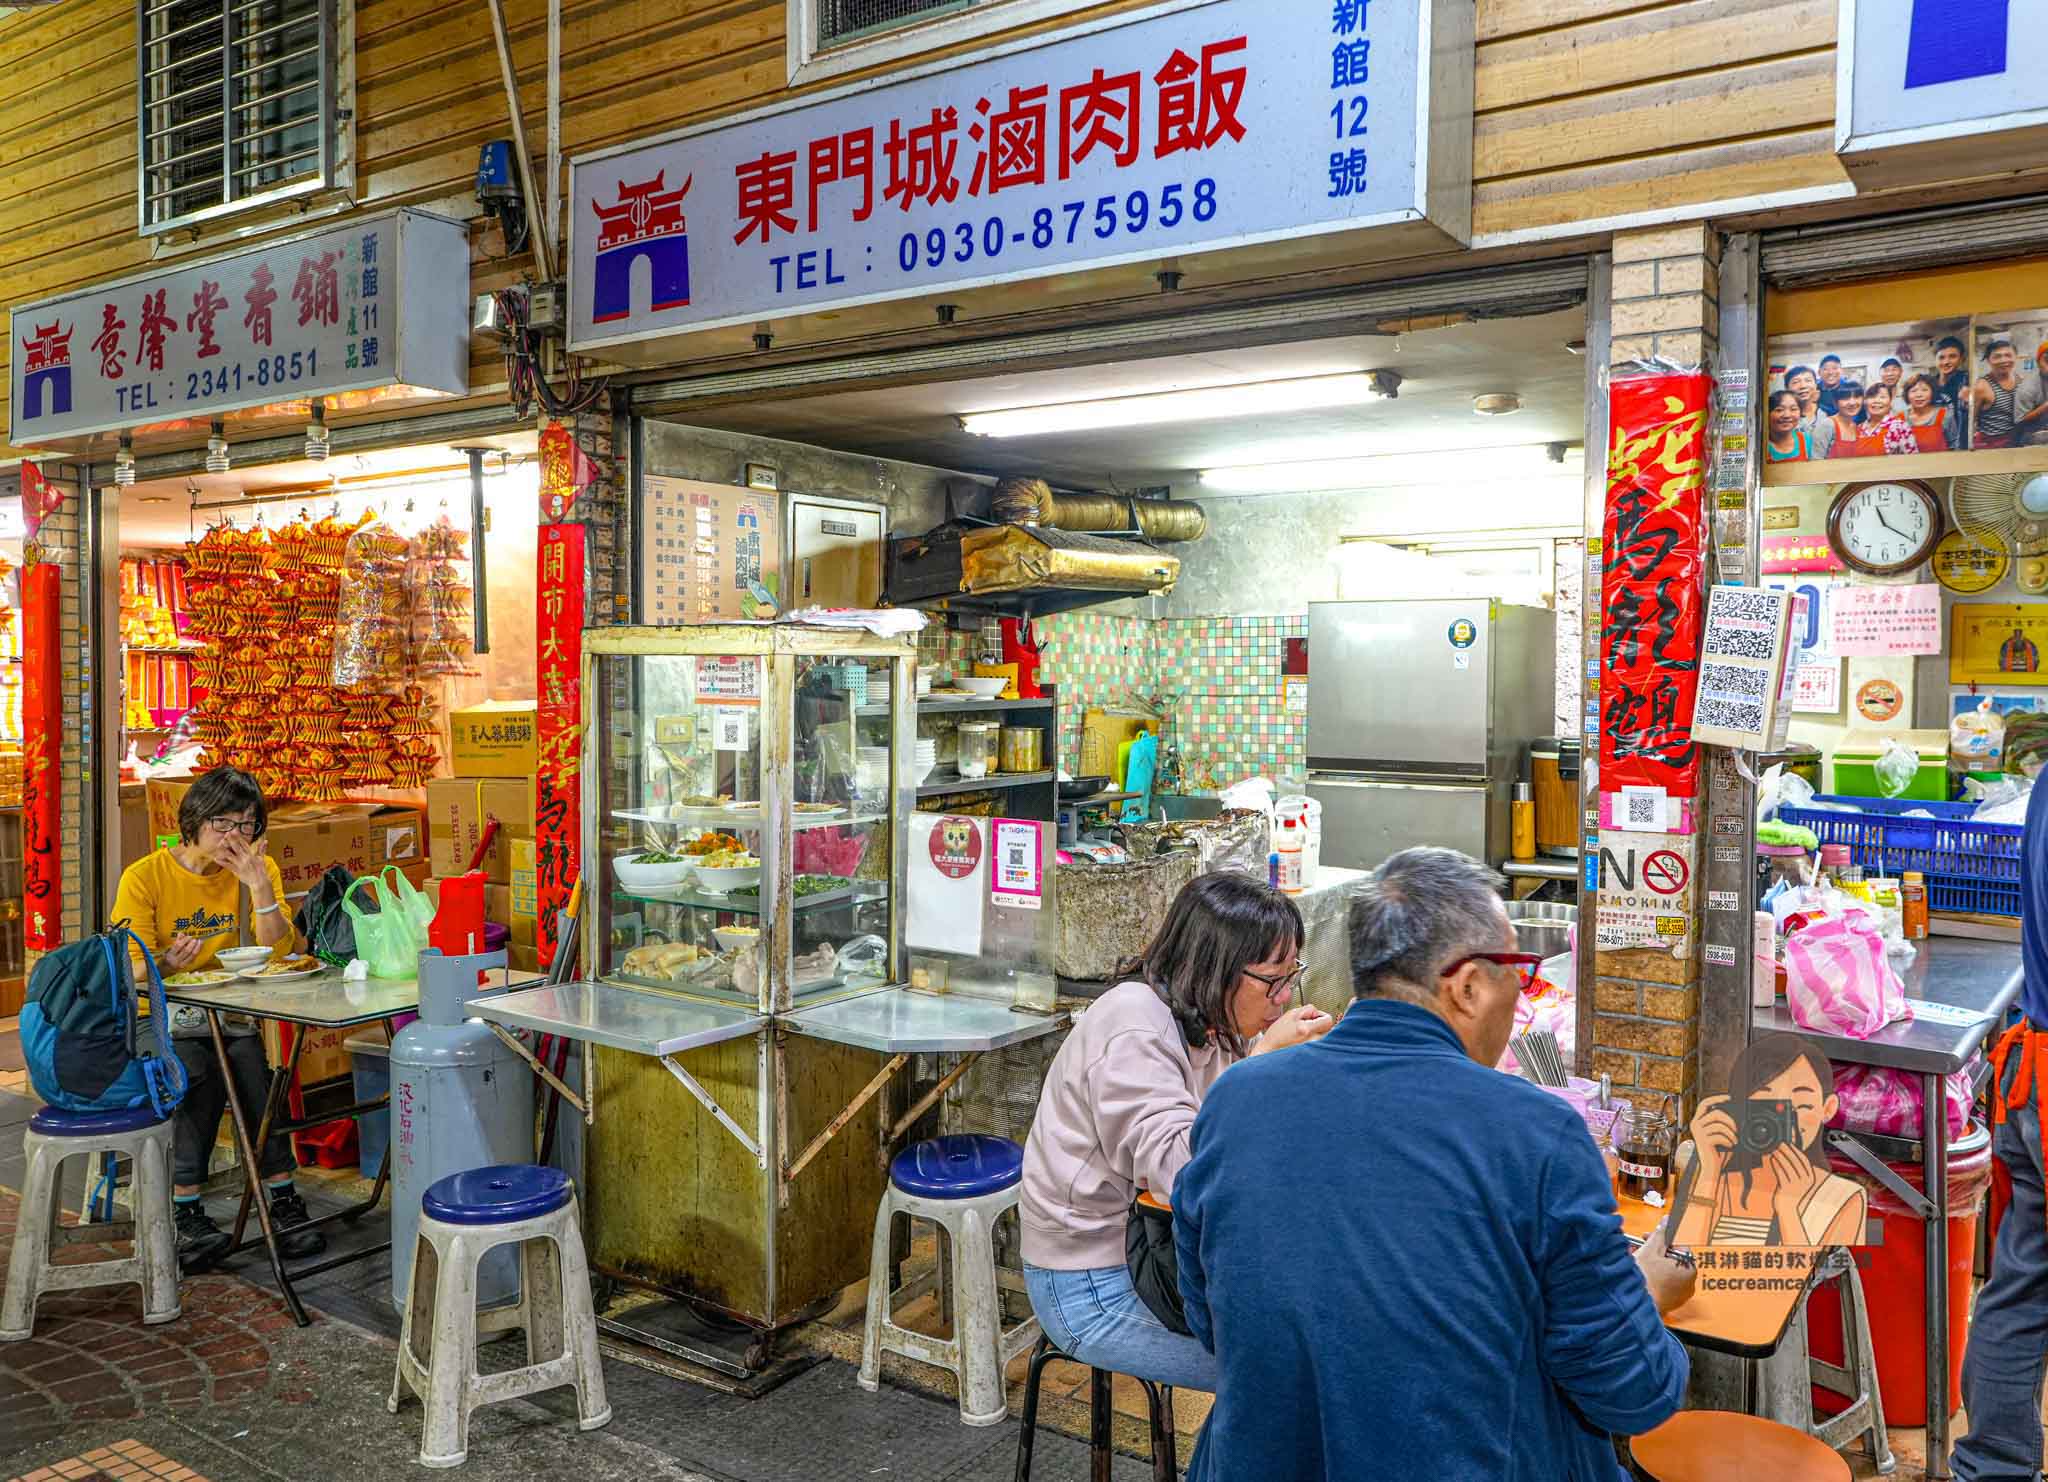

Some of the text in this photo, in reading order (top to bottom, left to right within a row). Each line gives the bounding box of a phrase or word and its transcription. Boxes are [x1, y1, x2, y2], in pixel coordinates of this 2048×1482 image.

[1328, 0, 1371, 197] 新館12號
[733, 35, 1248, 247] 東門城滷肉飯
[899, 177, 1217, 272] 0930-875958
[361, 232, 378, 368] 新館11號
[187, 348, 317, 401] 2341-8851
[1862, 494, 1871, 506] 11
[1879, 488, 1889, 501] 12
[1900, 492, 1904, 504] 1
[1849, 505, 1860, 518] 10
[1910, 501, 1918, 513] 2
[1847, 522, 1854, 533] 9
[1915, 515, 1923, 529] 3
[1852, 536, 1859, 547] 8
[1911, 532, 1917, 544] 4
[1864, 545, 1872, 558] 7
[1881, 548, 1889, 560] 6
[1899, 544, 1906, 555] 5
[541, 541, 568, 704] 開市大吉
[1597, 934, 1624, 946] 2396-5073
